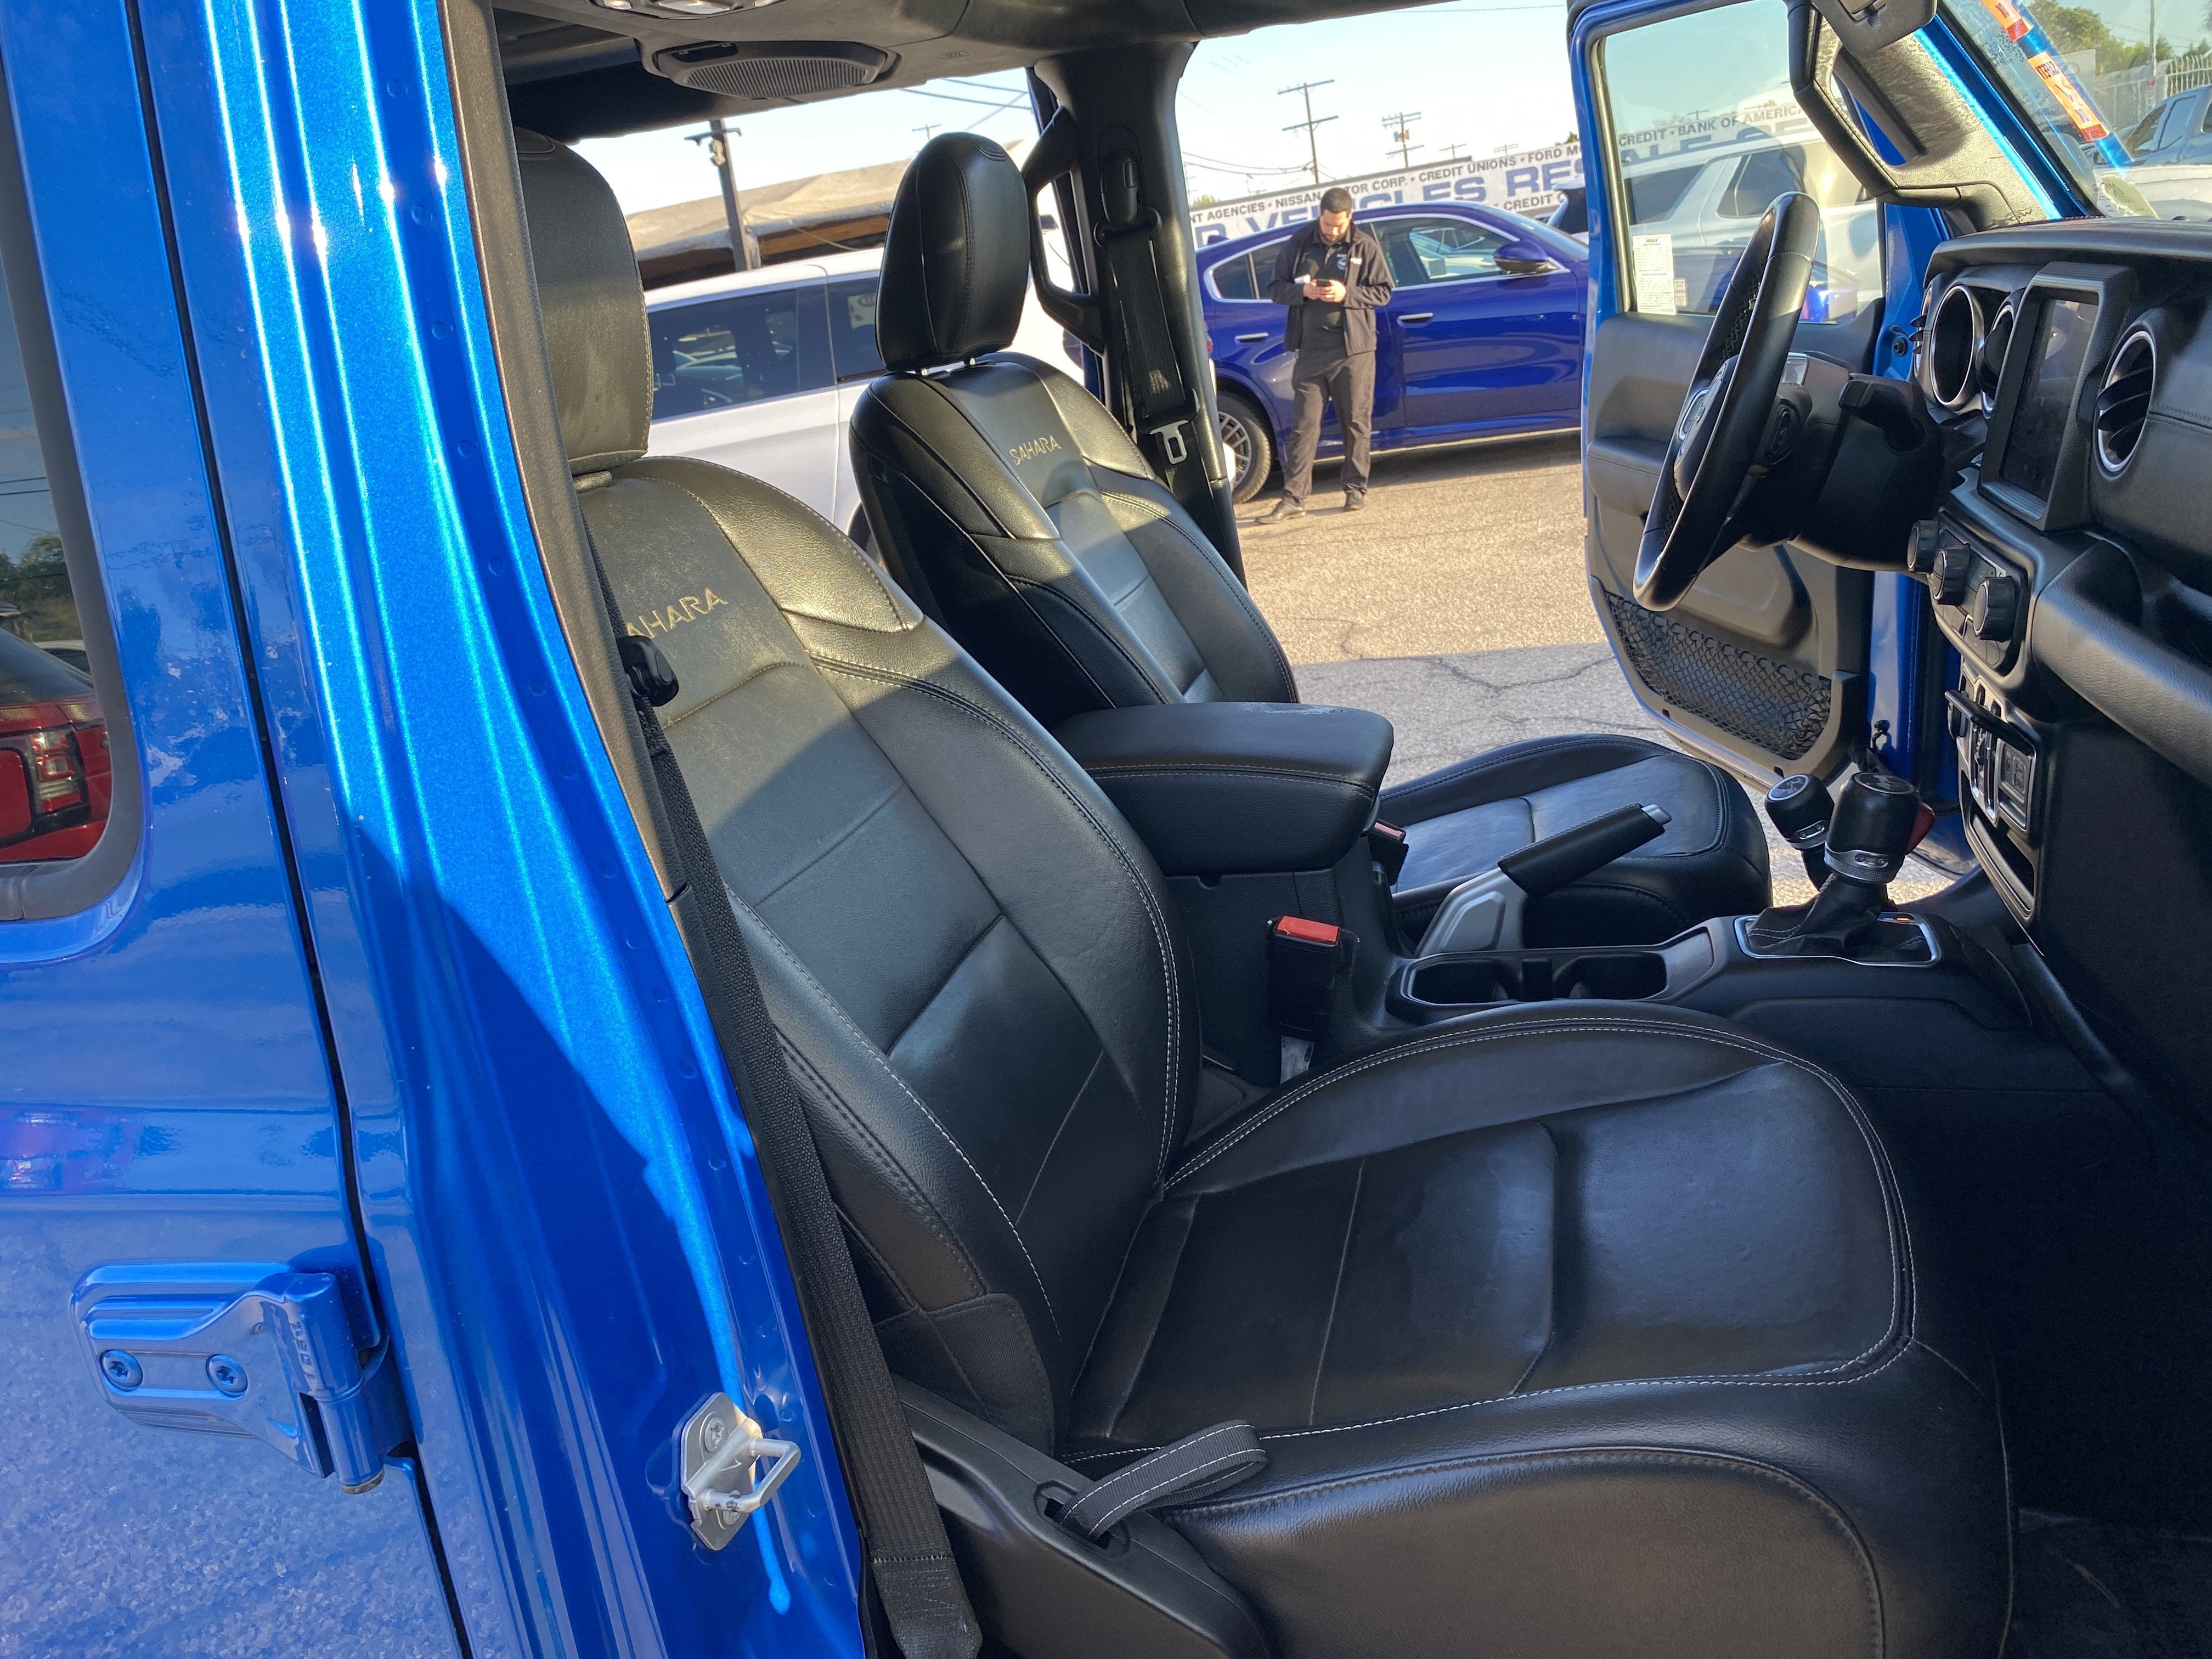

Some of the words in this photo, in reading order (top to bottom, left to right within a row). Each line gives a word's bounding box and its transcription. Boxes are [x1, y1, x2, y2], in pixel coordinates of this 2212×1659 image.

[1207, 202, 1265, 221] AGENCIES
[1275, 191, 1322, 208] NISSAN
[1419, 166, 1463, 182] CREDIT
[1467, 156, 1516, 174] UNIONS
[1527, 148, 1562, 163] FORD
[1619, 128, 1666, 146] CREDIT
[1678, 120, 1716, 136] BANK
[1503, 194, 1553, 211] CREDIT
[1009, 435, 1062, 466] SAHARA
[625, 588, 729, 639] AHARA
